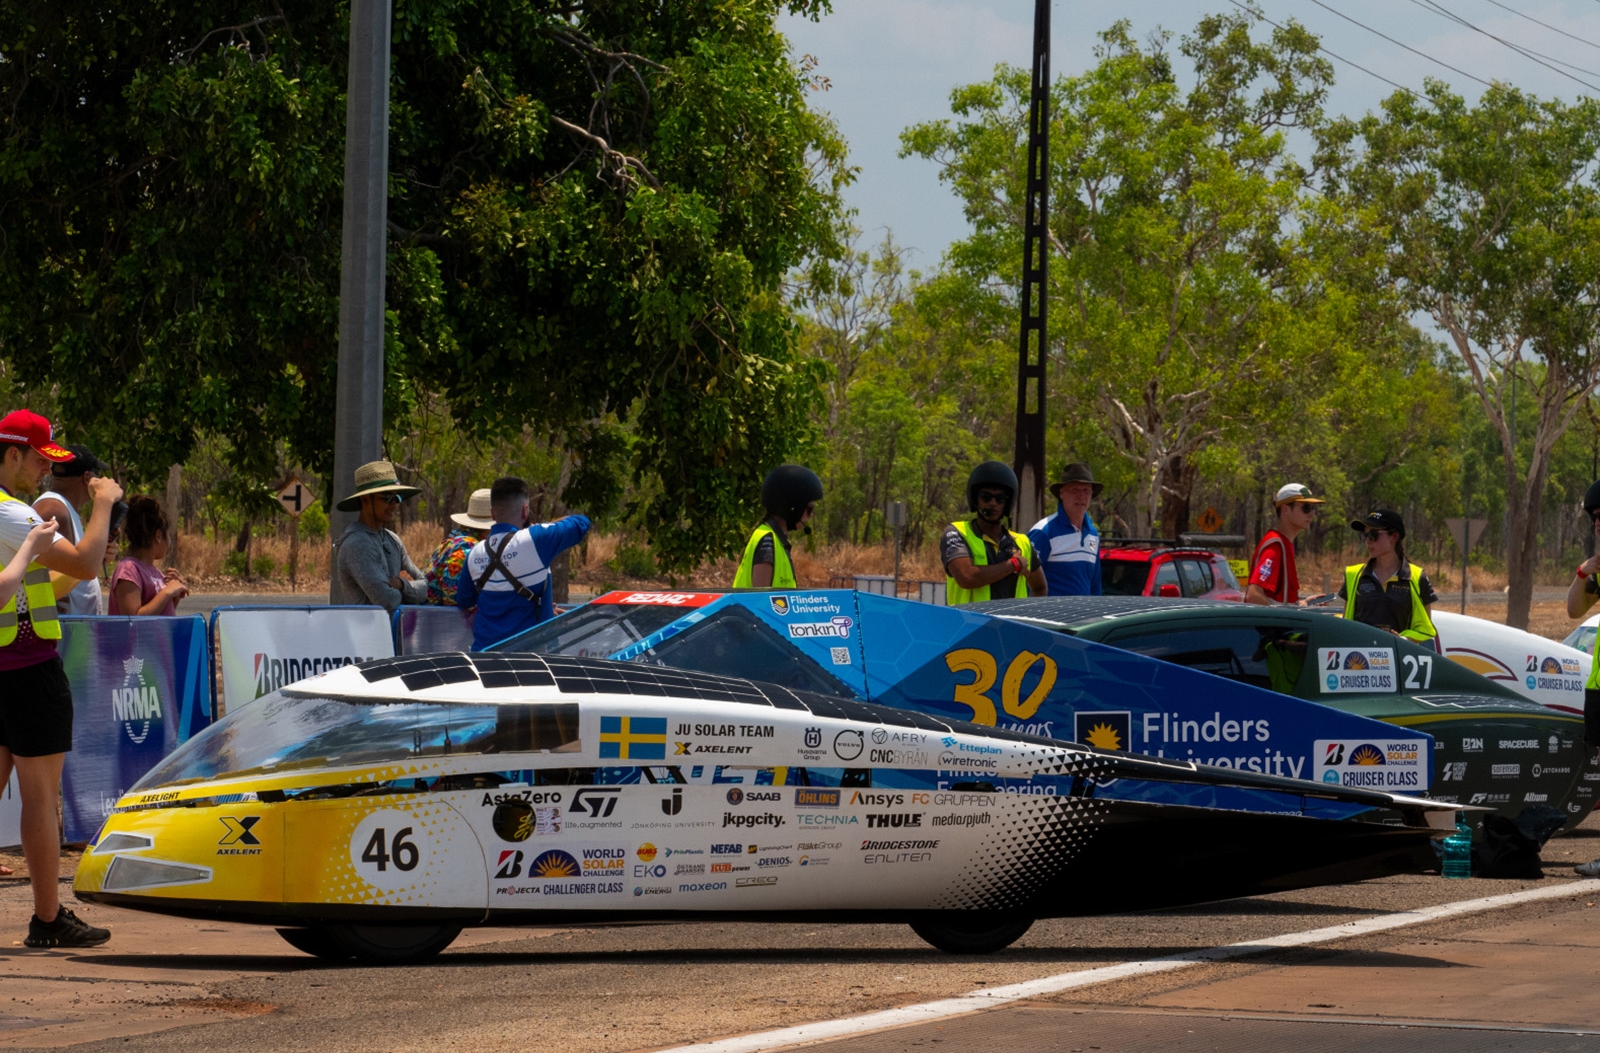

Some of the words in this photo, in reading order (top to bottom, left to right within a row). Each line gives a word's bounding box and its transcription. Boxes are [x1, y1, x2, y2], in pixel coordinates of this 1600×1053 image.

[790, 595, 828, 604] Flinders
[792, 604, 840, 613] University
[1402, 655, 1432, 689] 27
[945, 648, 1058, 727] 30
[1340, 675, 1369, 688] CRUISER
[1371, 675, 1391, 688] CLASS
[1538, 678, 1563, 689] CRUISER
[1564, 680, 1582, 691] CLASS
[112, 686, 162, 721] NRMA
[675, 724, 691, 736] JU
[694, 724, 735, 737] SOLAR
[740, 725, 774, 738] TEAM
[1143, 712, 1270, 742] Flinders
[892, 732, 928, 743] AFRY
[694, 745, 753, 754] AXELENT
[959, 743, 1002, 755] Etteplan
[1387, 743, 1418, 752] WORLD
[941, 755, 997, 768] wiretronic
[1387, 752, 1418, 760] SOLAR
[1343, 771, 1384, 786] CRUISER
[1387, 771, 1418, 786] CLASS
[140, 792, 181, 803] AXELIGHT
[746, 792, 781, 801] SAAB
[798, 790, 837, 803] ÖHLINS
[849, 791, 904, 808] Ansys
[911, 793, 930, 805] FC
[934, 794, 996, 807] GRUPPEN
[796, 814, 859, 825] TECHNIA
[866, 813, 922, 828] THULE
[361, 827, 419, 872] 46
[710, 844, 742, 854] NEFAB
[860, 840, 940, 850] BRIDGESTONE
[583, 848, 625, 859] WORLD
[583, 859, 625, 869] SOLAR
[758, 856, 790, 866] DENIOS
[583, 869, 625, 877] CHALLENGE
[634, 864, 667, 877] EKO
[543, 883, 596, 895] CHALLENGER
[597, 882, 623, 894] CLASS
